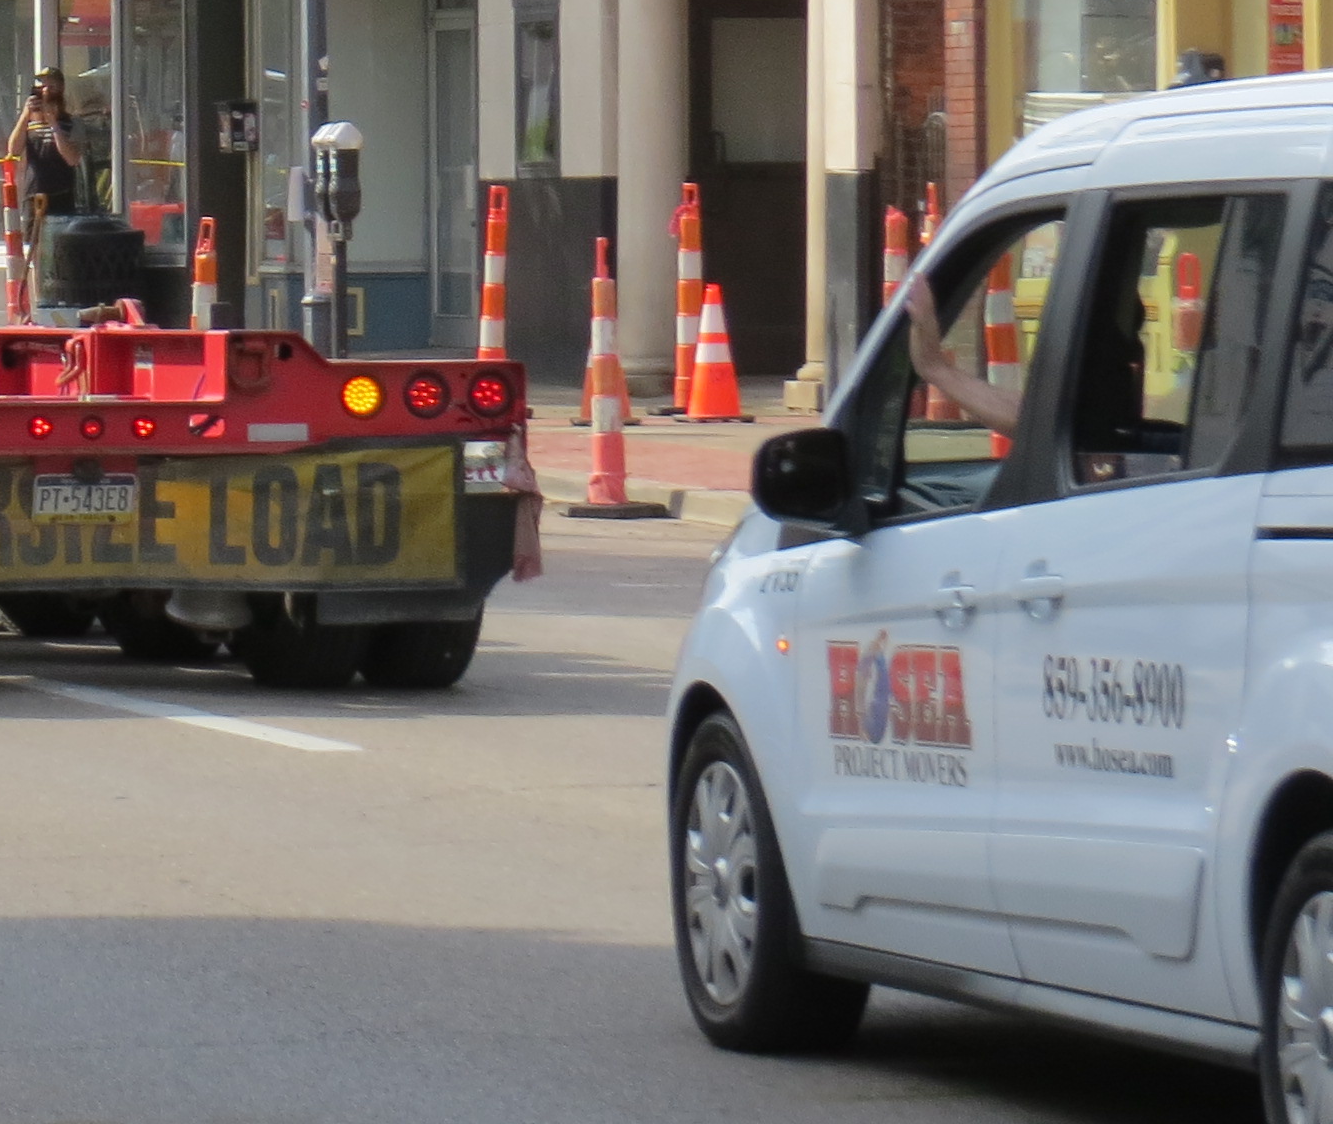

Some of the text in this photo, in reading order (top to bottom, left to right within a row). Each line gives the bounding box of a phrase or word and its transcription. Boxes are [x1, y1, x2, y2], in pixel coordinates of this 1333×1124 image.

[209, 461, 400, 568] LOAD
[1043, 654, 1185, 729] 859-356-8900
[834, 744, 967, 787] PROJECT MOVERS
[1054, 738, 1174, 778] www.hosea.com
